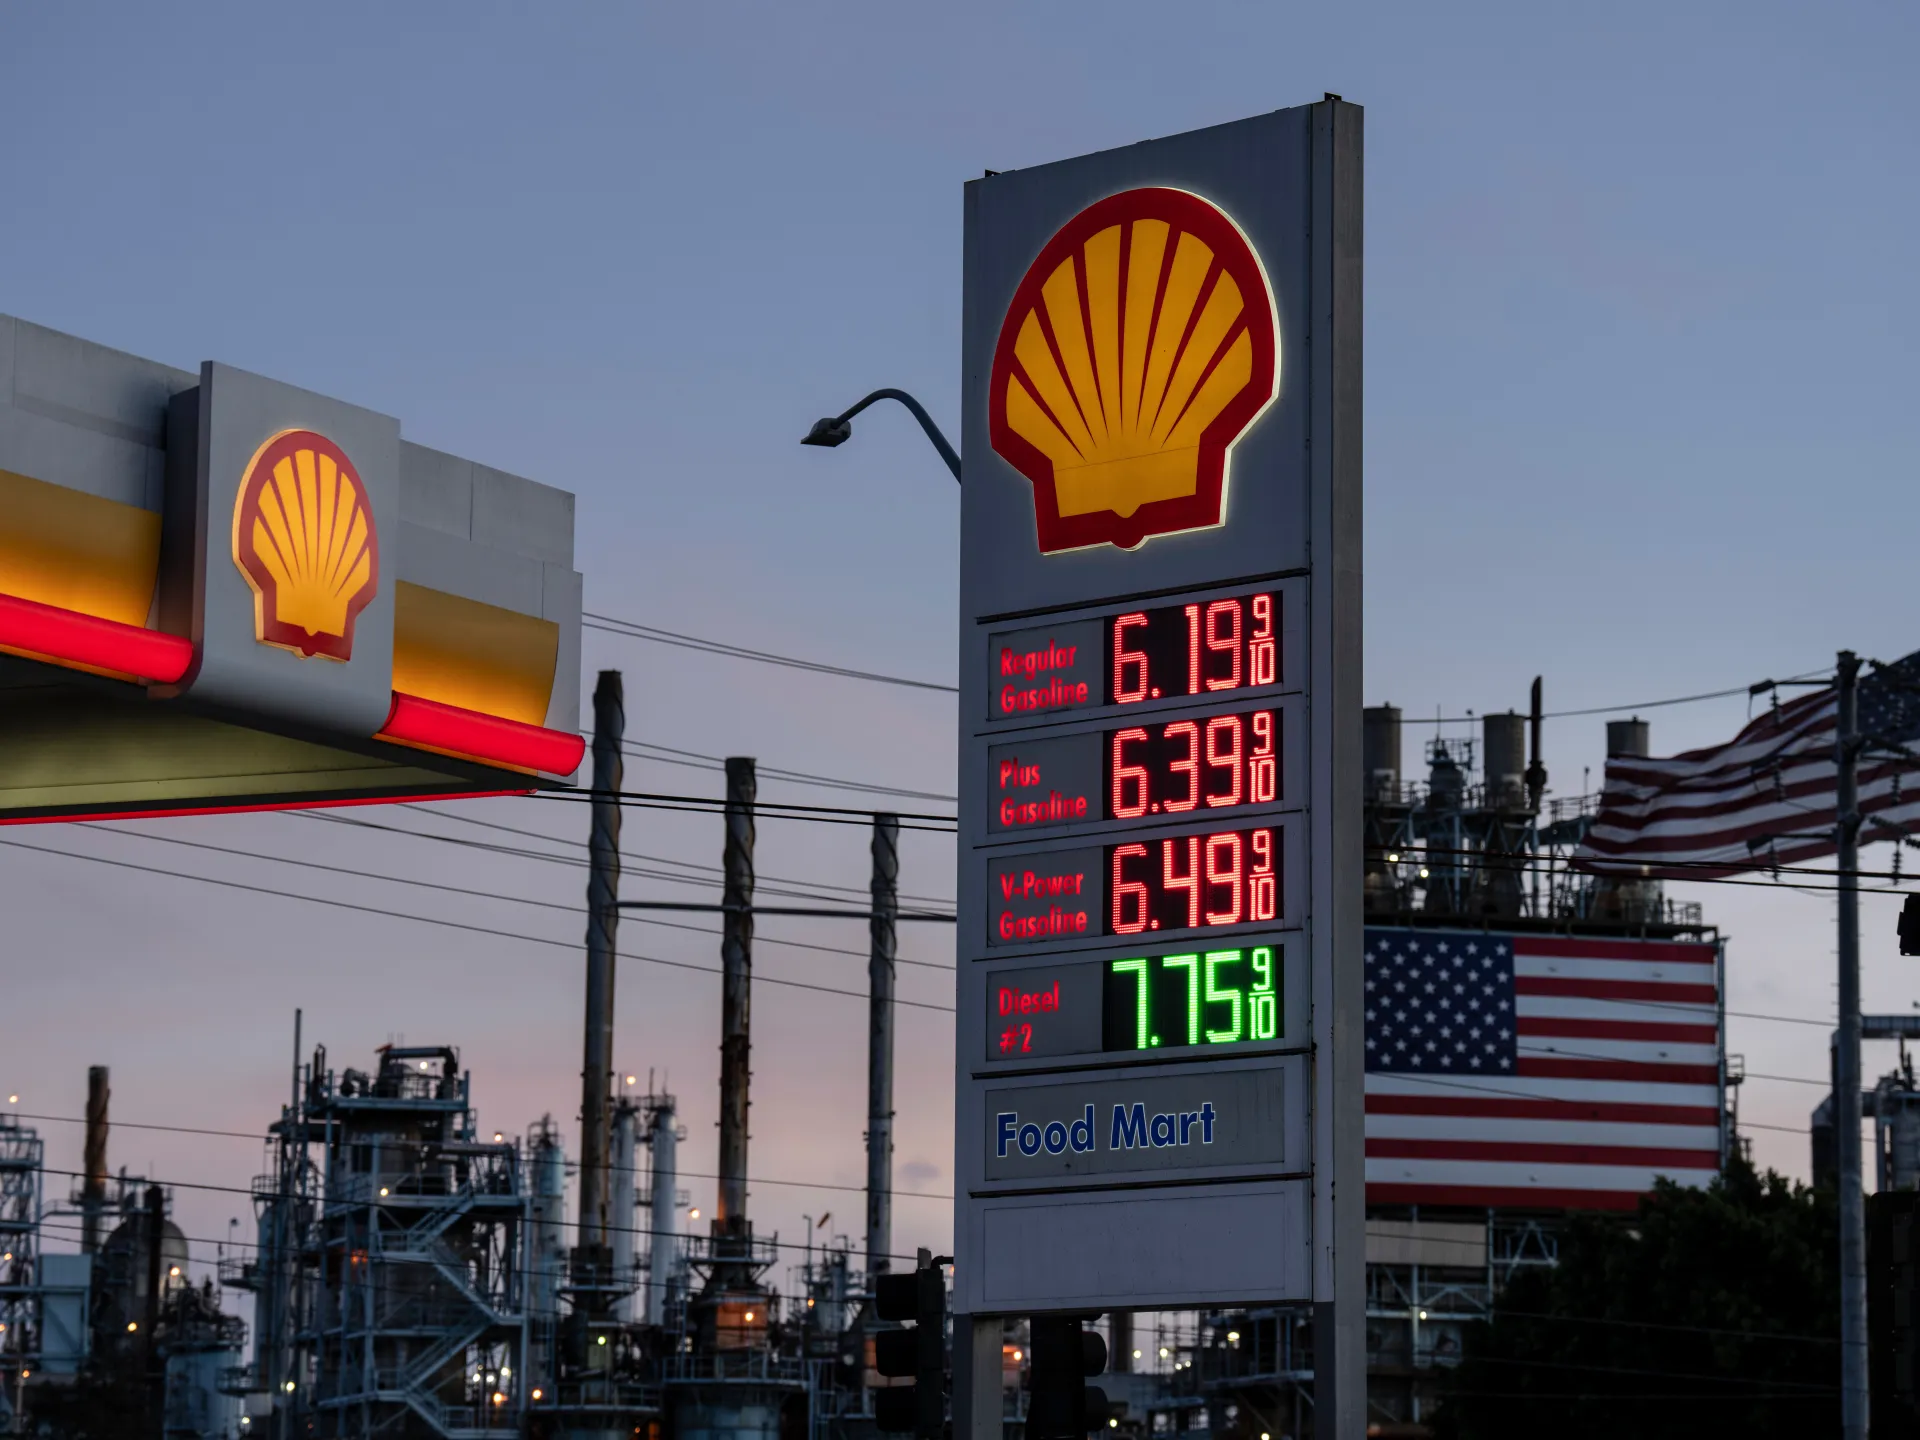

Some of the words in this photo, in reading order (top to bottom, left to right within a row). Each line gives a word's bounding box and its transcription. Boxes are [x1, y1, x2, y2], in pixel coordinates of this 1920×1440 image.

[1001, 639, 1077, 681] Regular
[1112, 600, 1242, 703] 6.19
[1001, 676, 1088, 713] Gasoline
[1000, 756, 1041, 789] Plus
[1112, 715, 1242, 819] 6.39
[1001, 790, 1087, 827] Gasoline
[1001, 871, 1084, 902] V-Power
[1112, 833, 1242, 934] 6.49
[1000, 905, 1088, 940] Gasoline
[1000, 980, 1060, 1016] Diesel
[1112, 949, 1242, 1050] 7.75
[1000, 1023, 1033, 1054] #2
[997, 1104, 1096, 1157] Food
[1110, 1102, 1216, 1150] Mart
